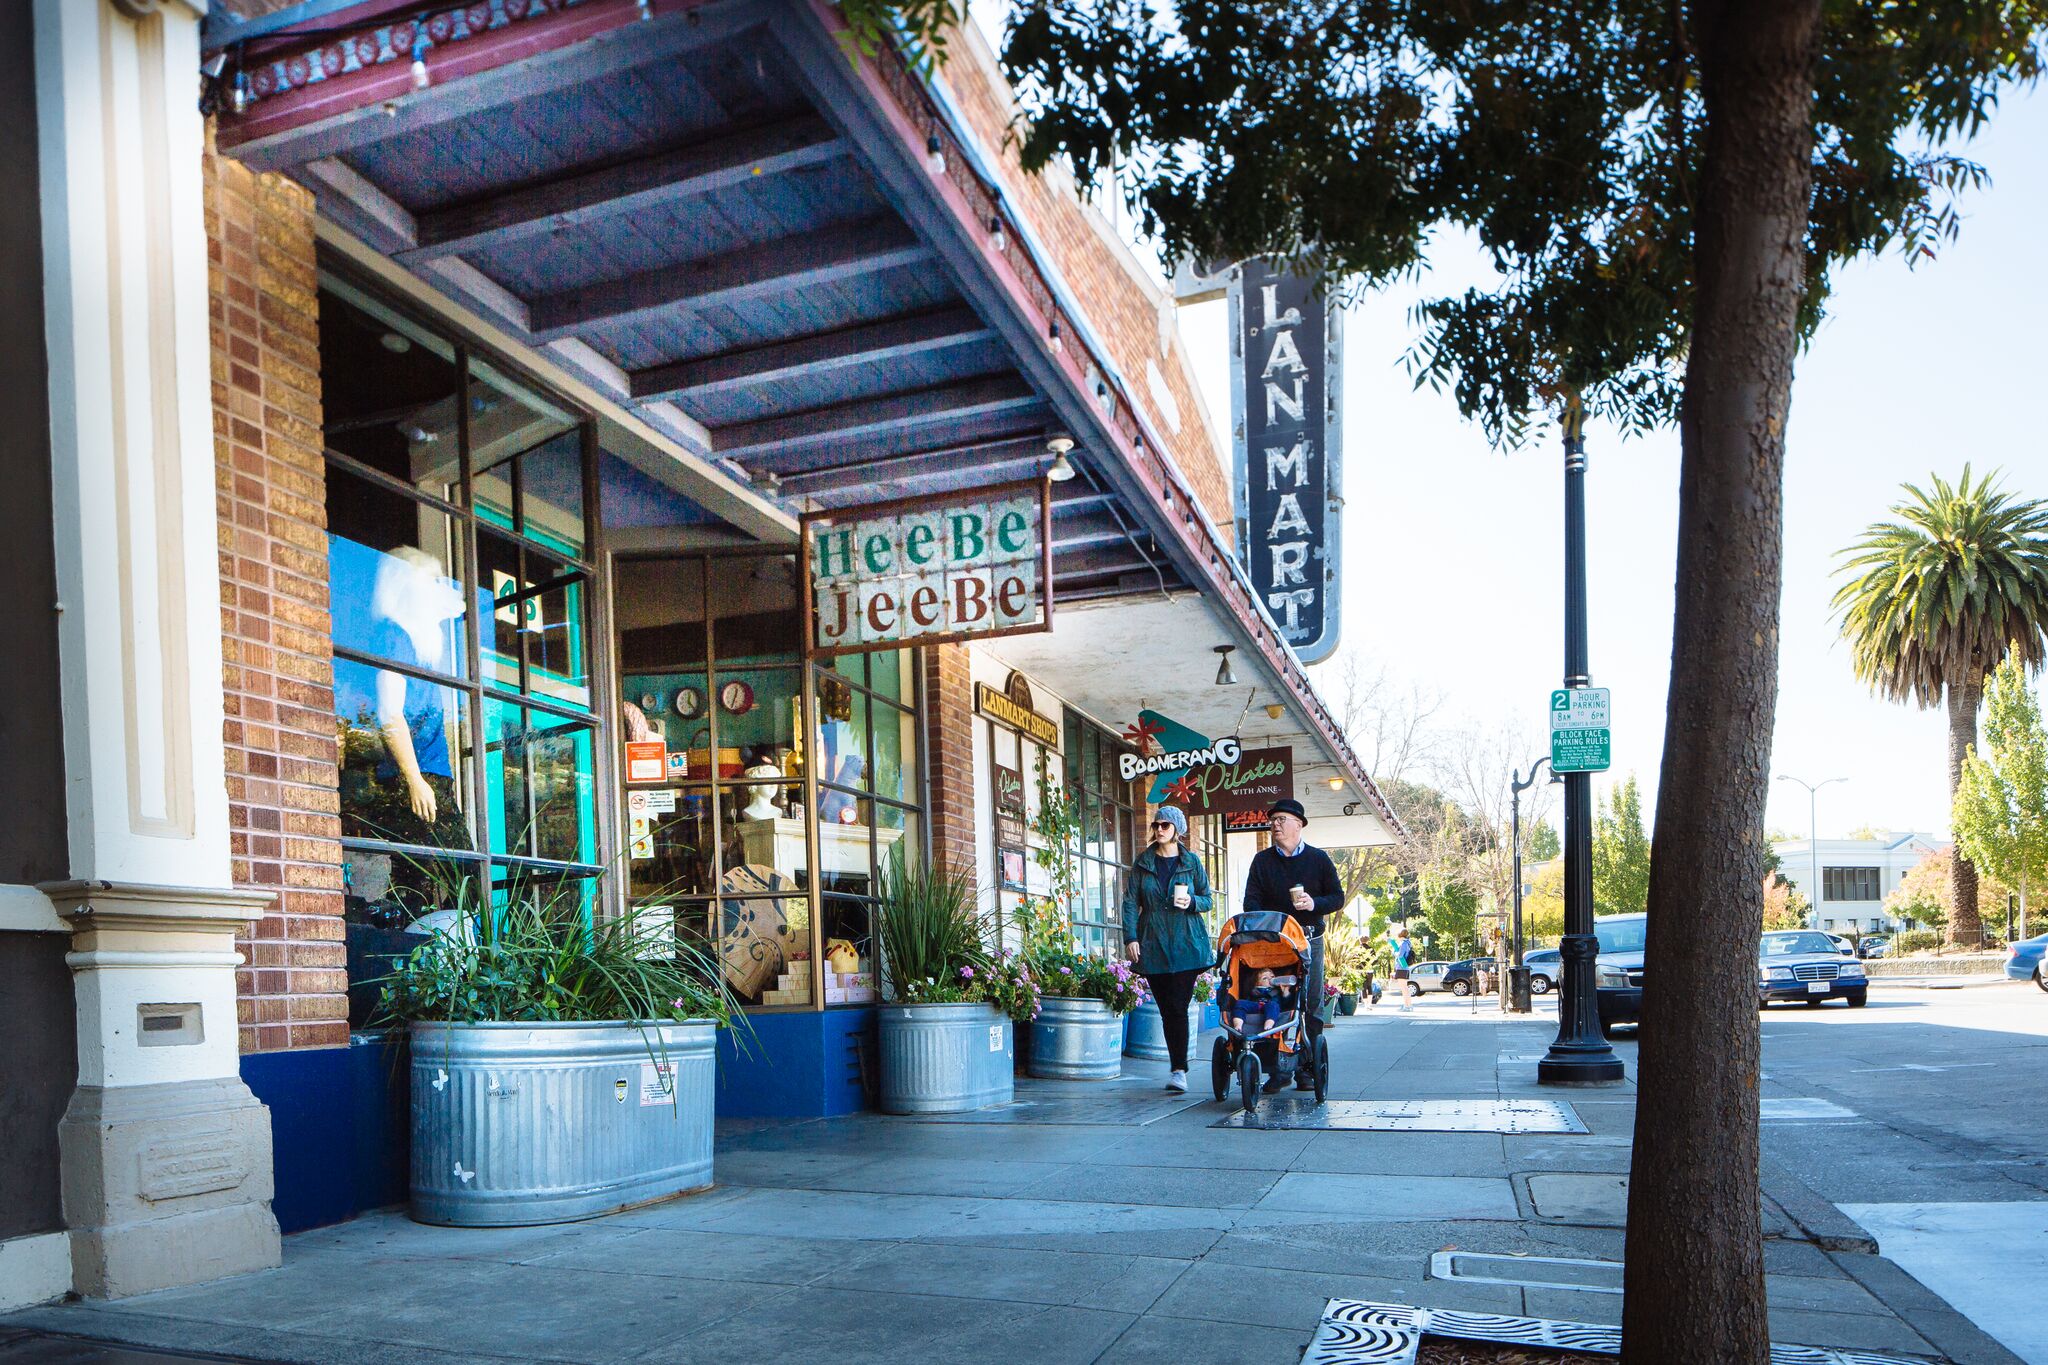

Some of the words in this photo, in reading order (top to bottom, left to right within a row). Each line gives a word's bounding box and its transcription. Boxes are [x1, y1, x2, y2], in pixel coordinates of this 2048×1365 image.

[1555, 692, 1566, 709] 2
[1578, 693, 1600, 701] HOUR
[1572, 701, 1606, 709] PARKING
[982, 687, 1030, 731] LANMART
[1031, 714, 1057, 744] SHOPS
[1557, 712, 1571, 721] 8AM
[1591, 711, 1604, 720] 6PM
[1554, 738, 1583, 746] PARKING
[1119, 738, 1240, 781] BOOMERANG
[1196, 758, 1286, 808] Pilates
[1256, 786, 1278, 795] ANNE
